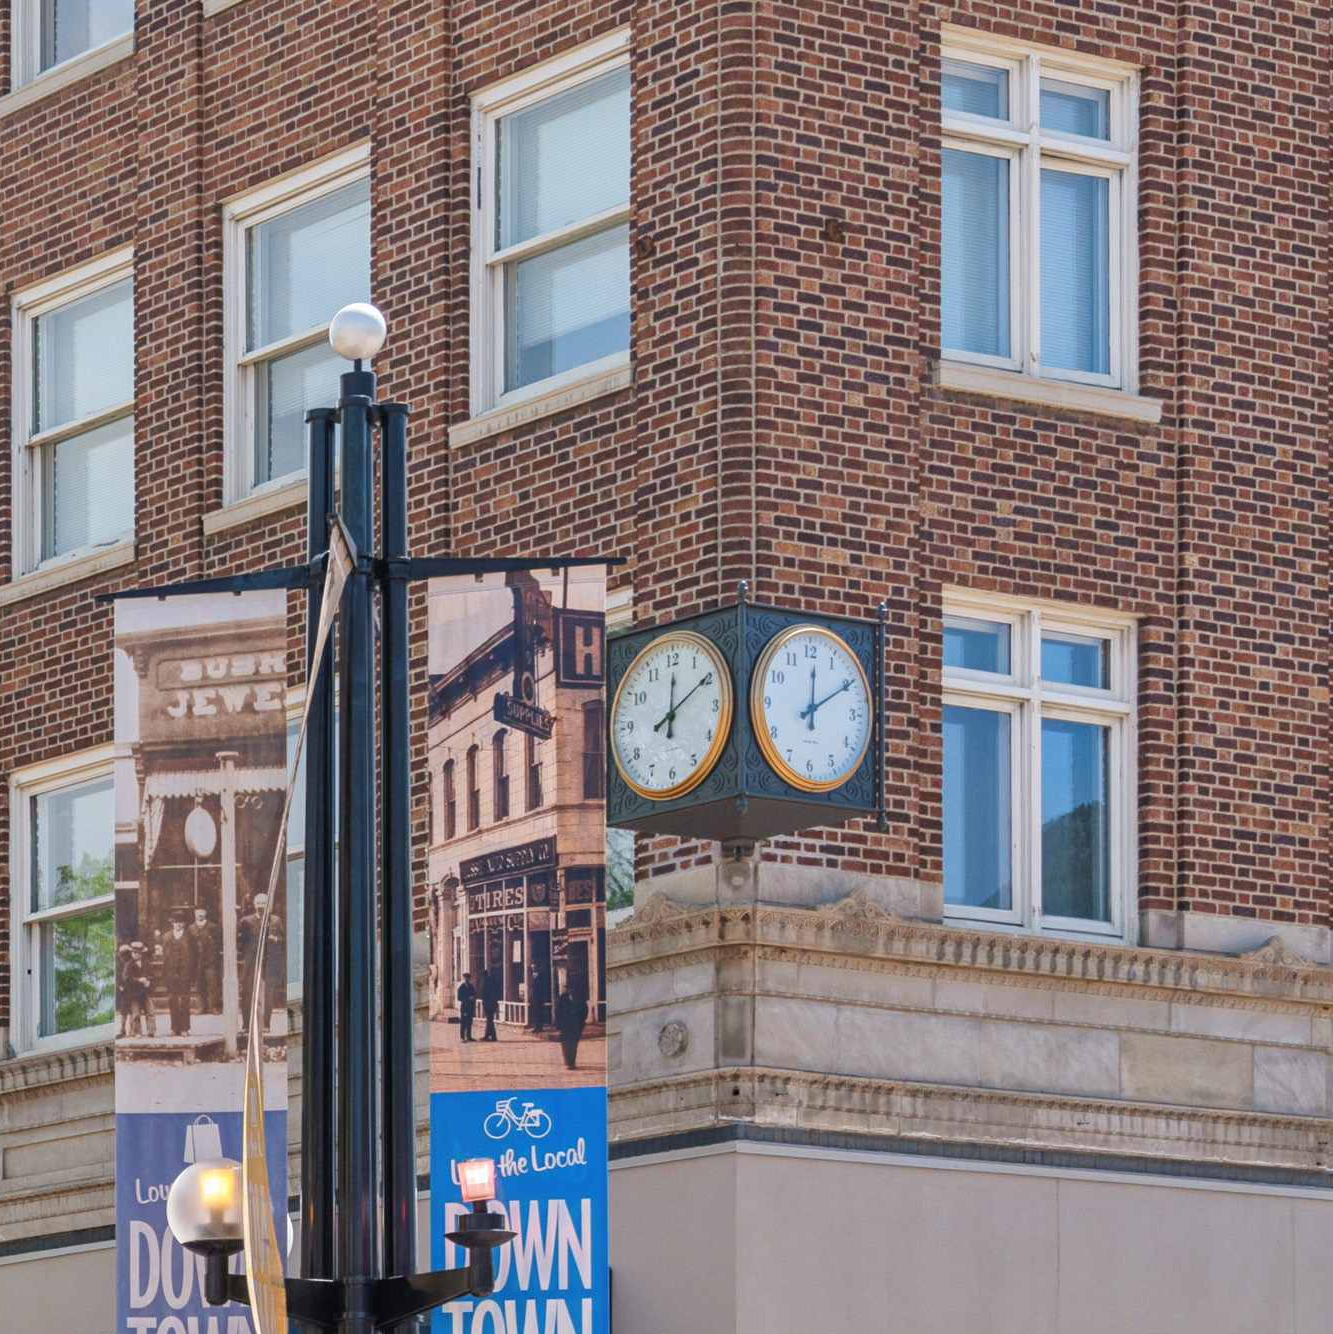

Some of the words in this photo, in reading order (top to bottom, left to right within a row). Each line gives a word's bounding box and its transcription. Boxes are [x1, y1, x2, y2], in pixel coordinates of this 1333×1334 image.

[804, 645, 817, 659] 12
[667, 653, 679, 668] 12
[692, 657, 696, 669] 1
[786, 652, 797, 666] 11
[829, 657, 834, 670] 1
[648, 668, 659, 682] 11
[771, 670, 784, 684] 10
[167, 682, 286, 717] JEWE
[634, 691, 646, 706] 10
[765, 696, 771, 709] 9
[712, 699, 719, 712] 3
[506, 701, 550, 732] SUPPLIES
[849, 708, 856, 721] 3
[627, 721, 633, 734] 9
[771, 726, 777, 739] 8
[705, 730, 712, 741] 4
[842, 736, 849, 747] 4
[633, 748, 640, 760] 8
[691, 754, 698, 767] 5
[786, 750, 793, 762] 7
[806, 760, 813, 772] 6
[828, 755, 833, 767] 5
[649, 764, 655, 777] 7
[669, 768, 676, 780] 6
[475, 886, 524, 911] TIRES
[501, 1148, 529, 1178] the
[531, 1137, 588, 1172] Local
